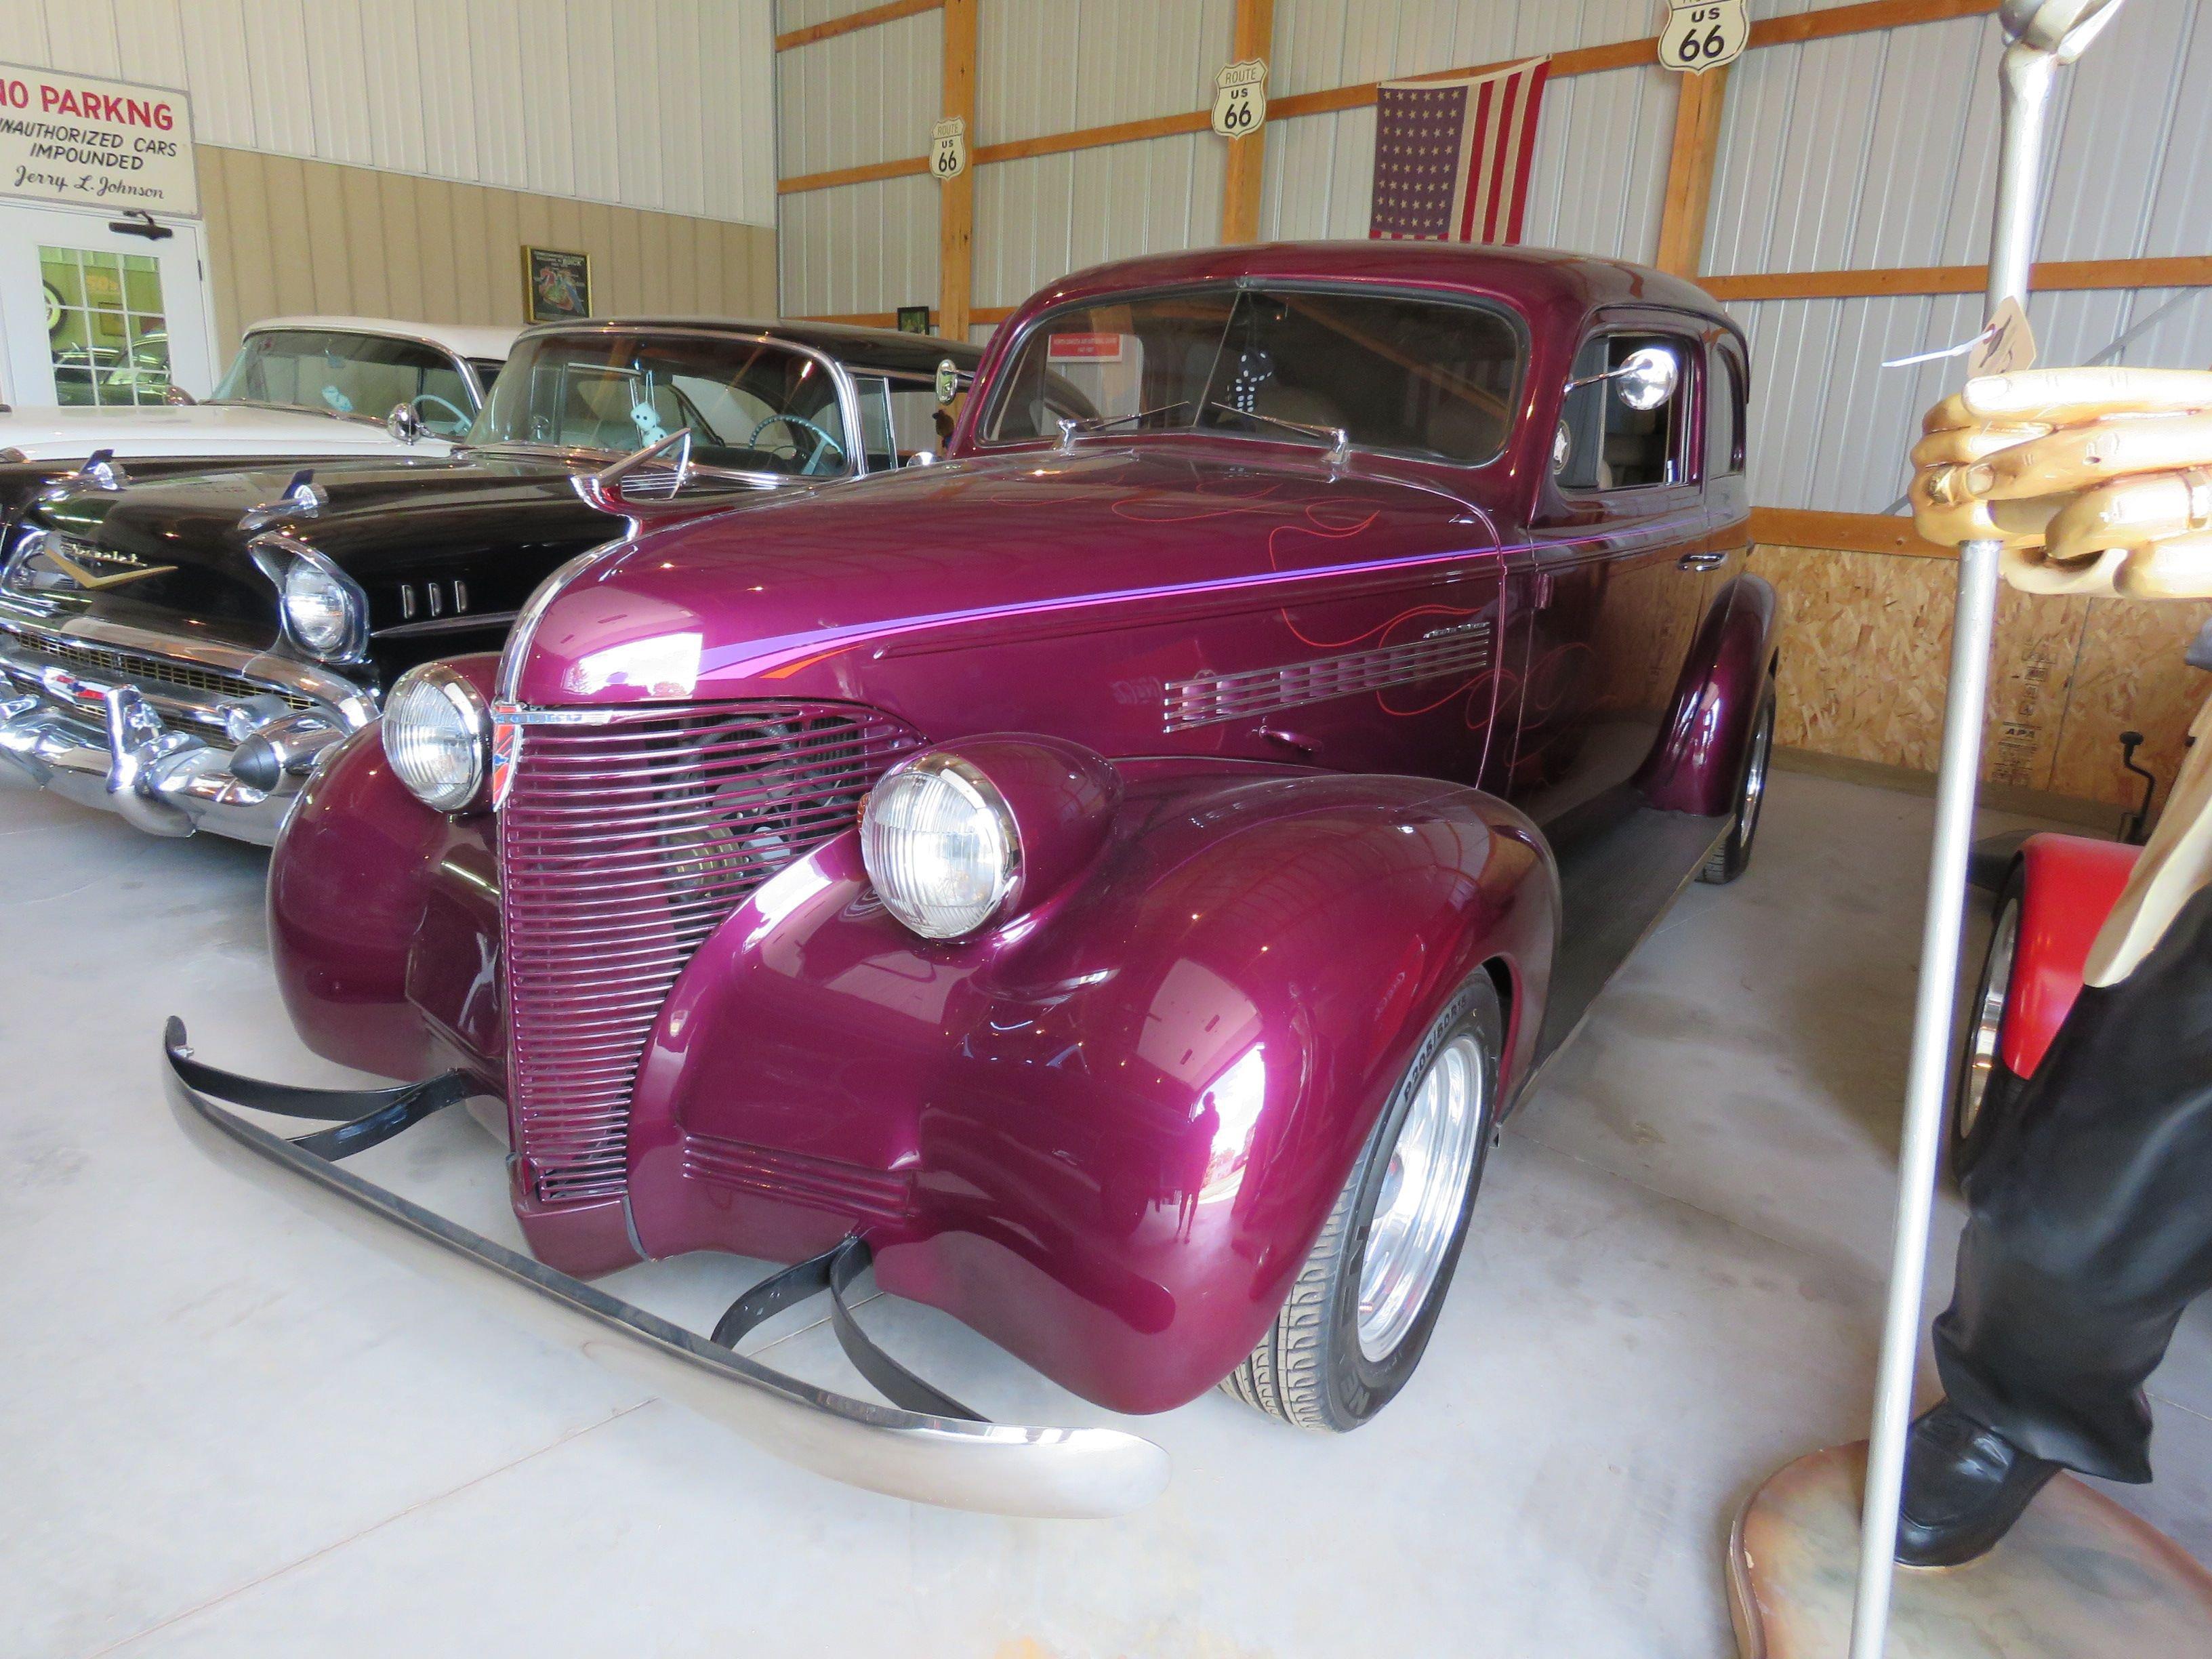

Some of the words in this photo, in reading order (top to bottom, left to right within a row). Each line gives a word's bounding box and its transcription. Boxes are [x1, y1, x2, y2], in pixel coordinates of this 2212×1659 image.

[1691, 7, 1720, 22] US
[1679, 24, 1724, 62] 66
[1225, 67, 1257, 85] ROUTE
[40, 85, 173, 130] PARKNG
[1231, 88, 1248, 100] US
[1225, 101, 1252, 129] 66
[0, 118, 124, 148] NAUTHORIZED
[134, 138, 177, 157] CARS
[941, 140, 954, 148] US
[30, 142, 144, 170] IMPOUNDED
[939, 150, 957, 172] 66
[14, 165, 68, 192] Jerry
[74, 175, 94, 191] L.
[96, 176, 164, 199] Johnson
